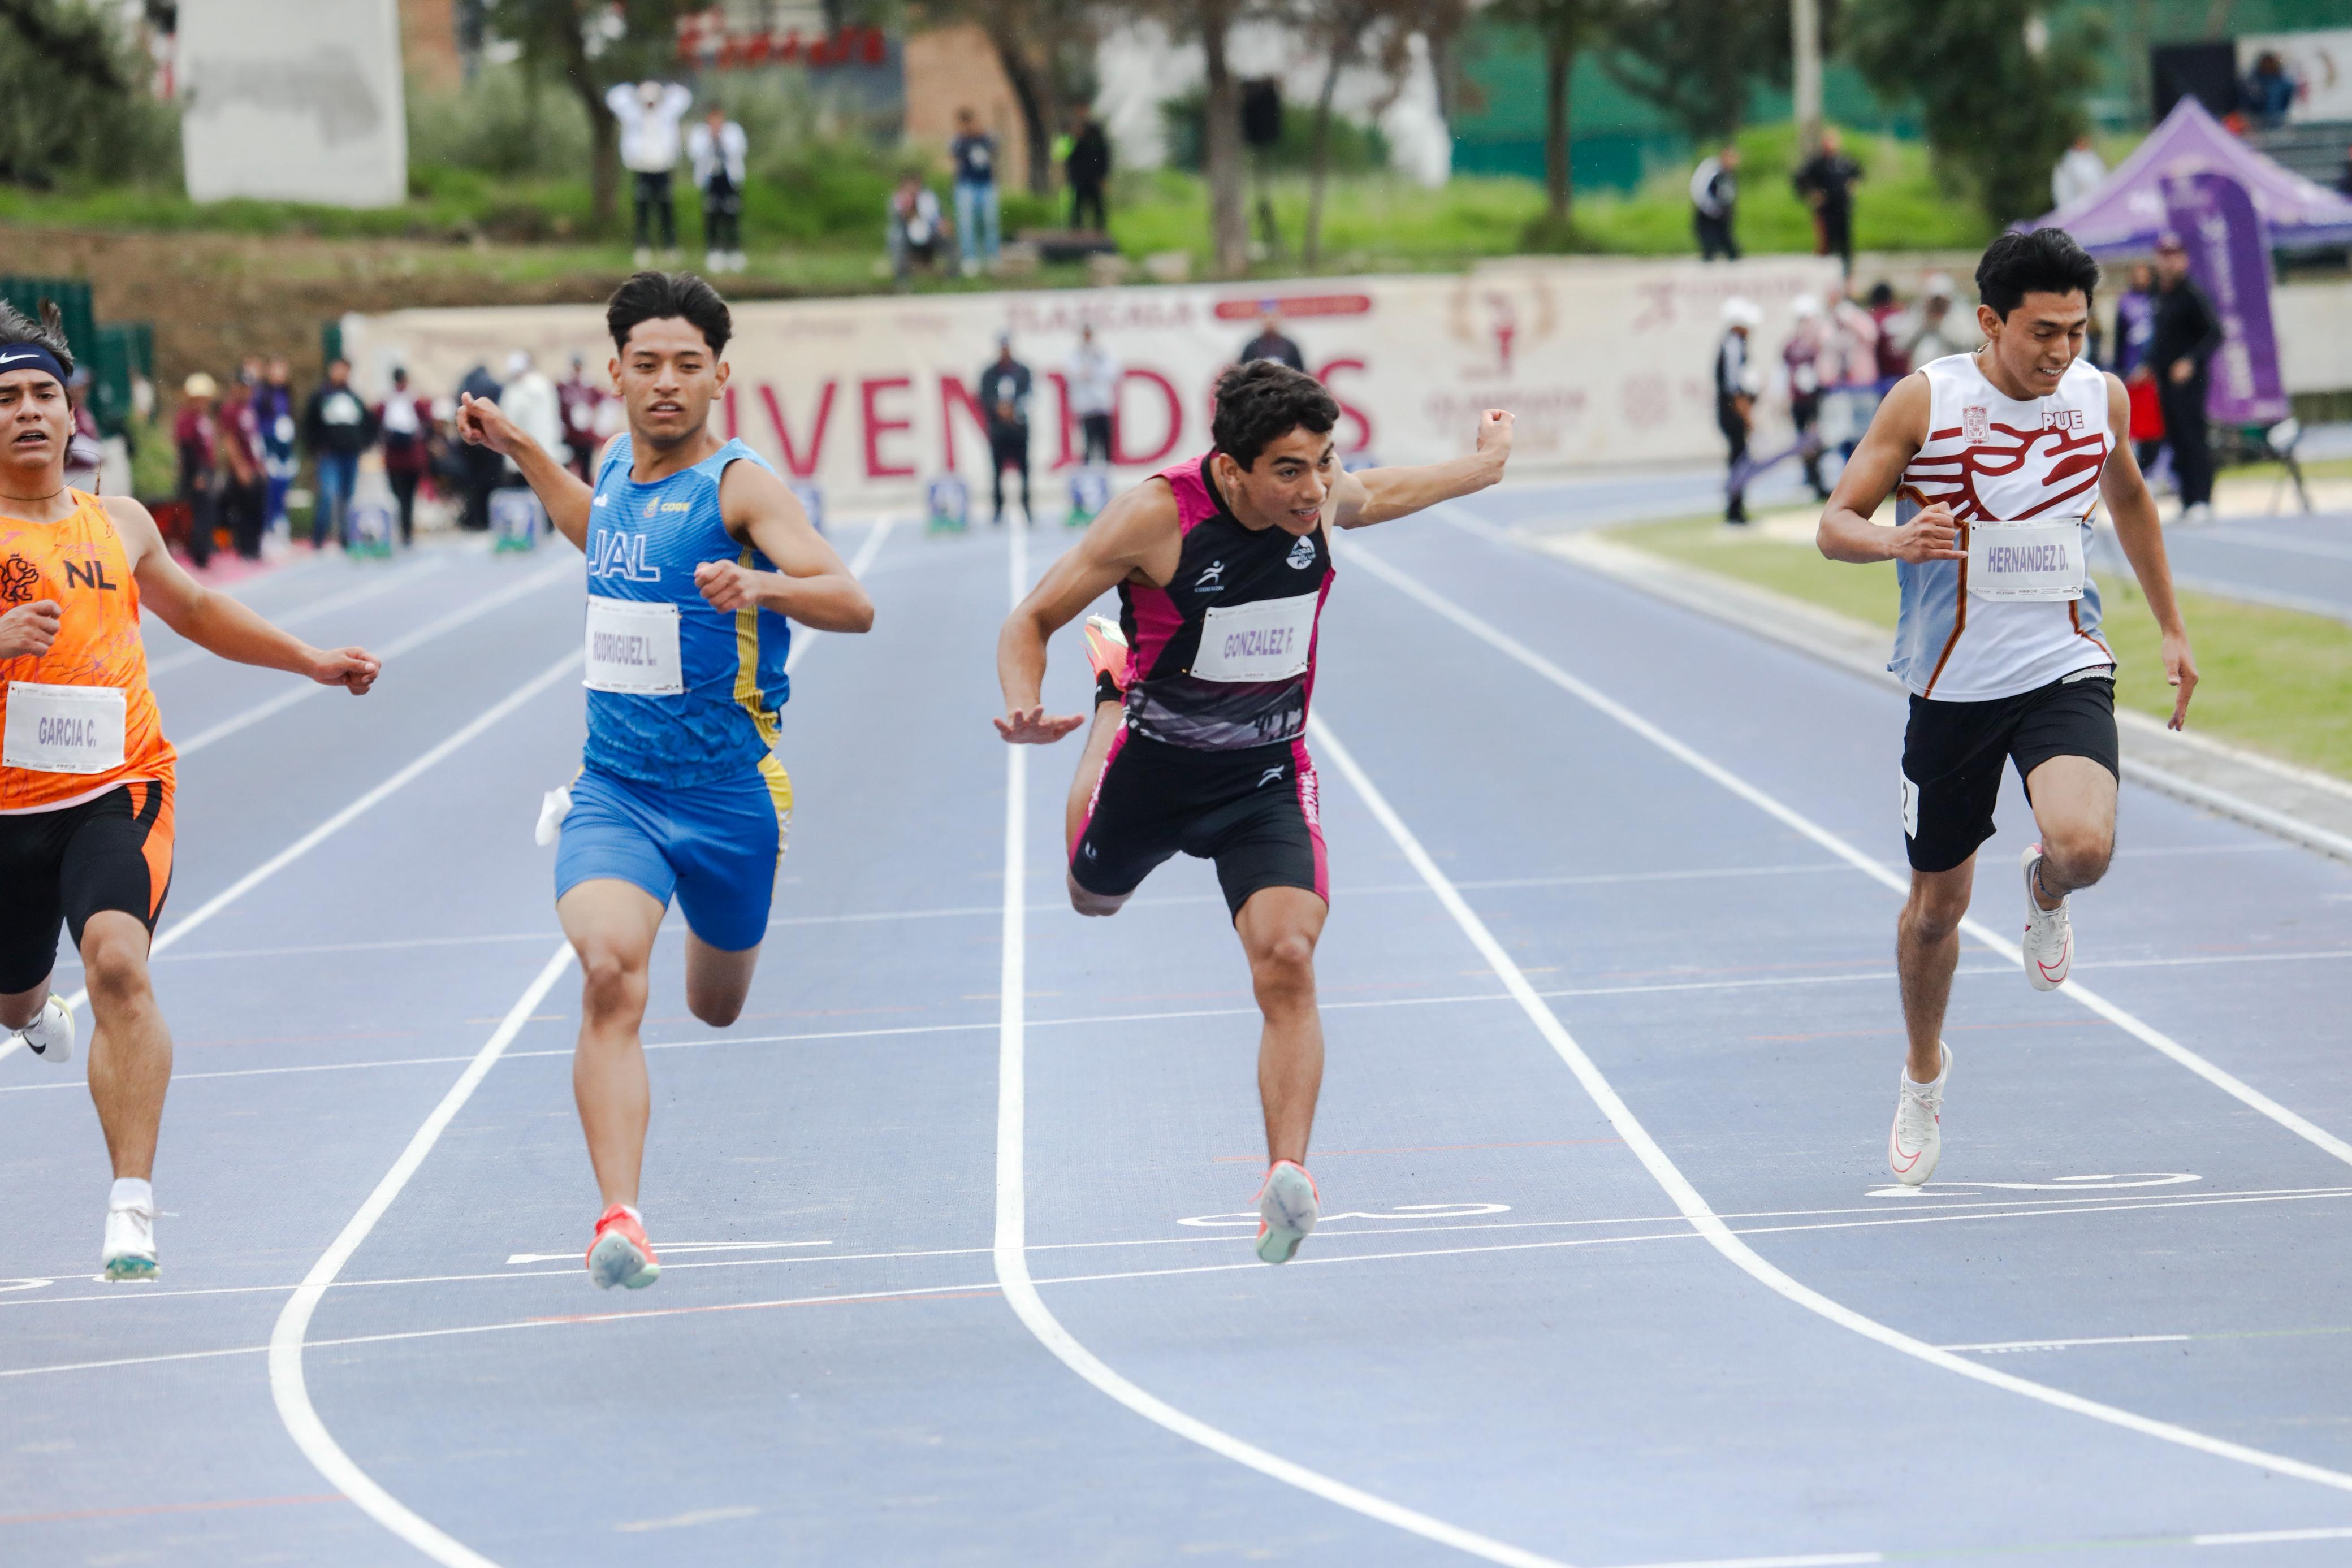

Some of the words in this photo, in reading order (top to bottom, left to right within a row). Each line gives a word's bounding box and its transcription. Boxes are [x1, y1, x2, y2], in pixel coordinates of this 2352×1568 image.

[2042, 410, 2084, 431] PUE
[589, 529, 661, 582] JAL
[1988, 545, 2056, 573] HERNANDEZ
[2059, 544, 2069, 570] D.
[63, 560, 116, 591] NL
[593, 631, 643, 665] RODRIGUEZ
[645, 637, 657, 666] L.
[1224, 629, 1285, 659] GONZALEZ
[38, 717, 83, 747] GARCIA
[87, 719, 97, 747] C.
